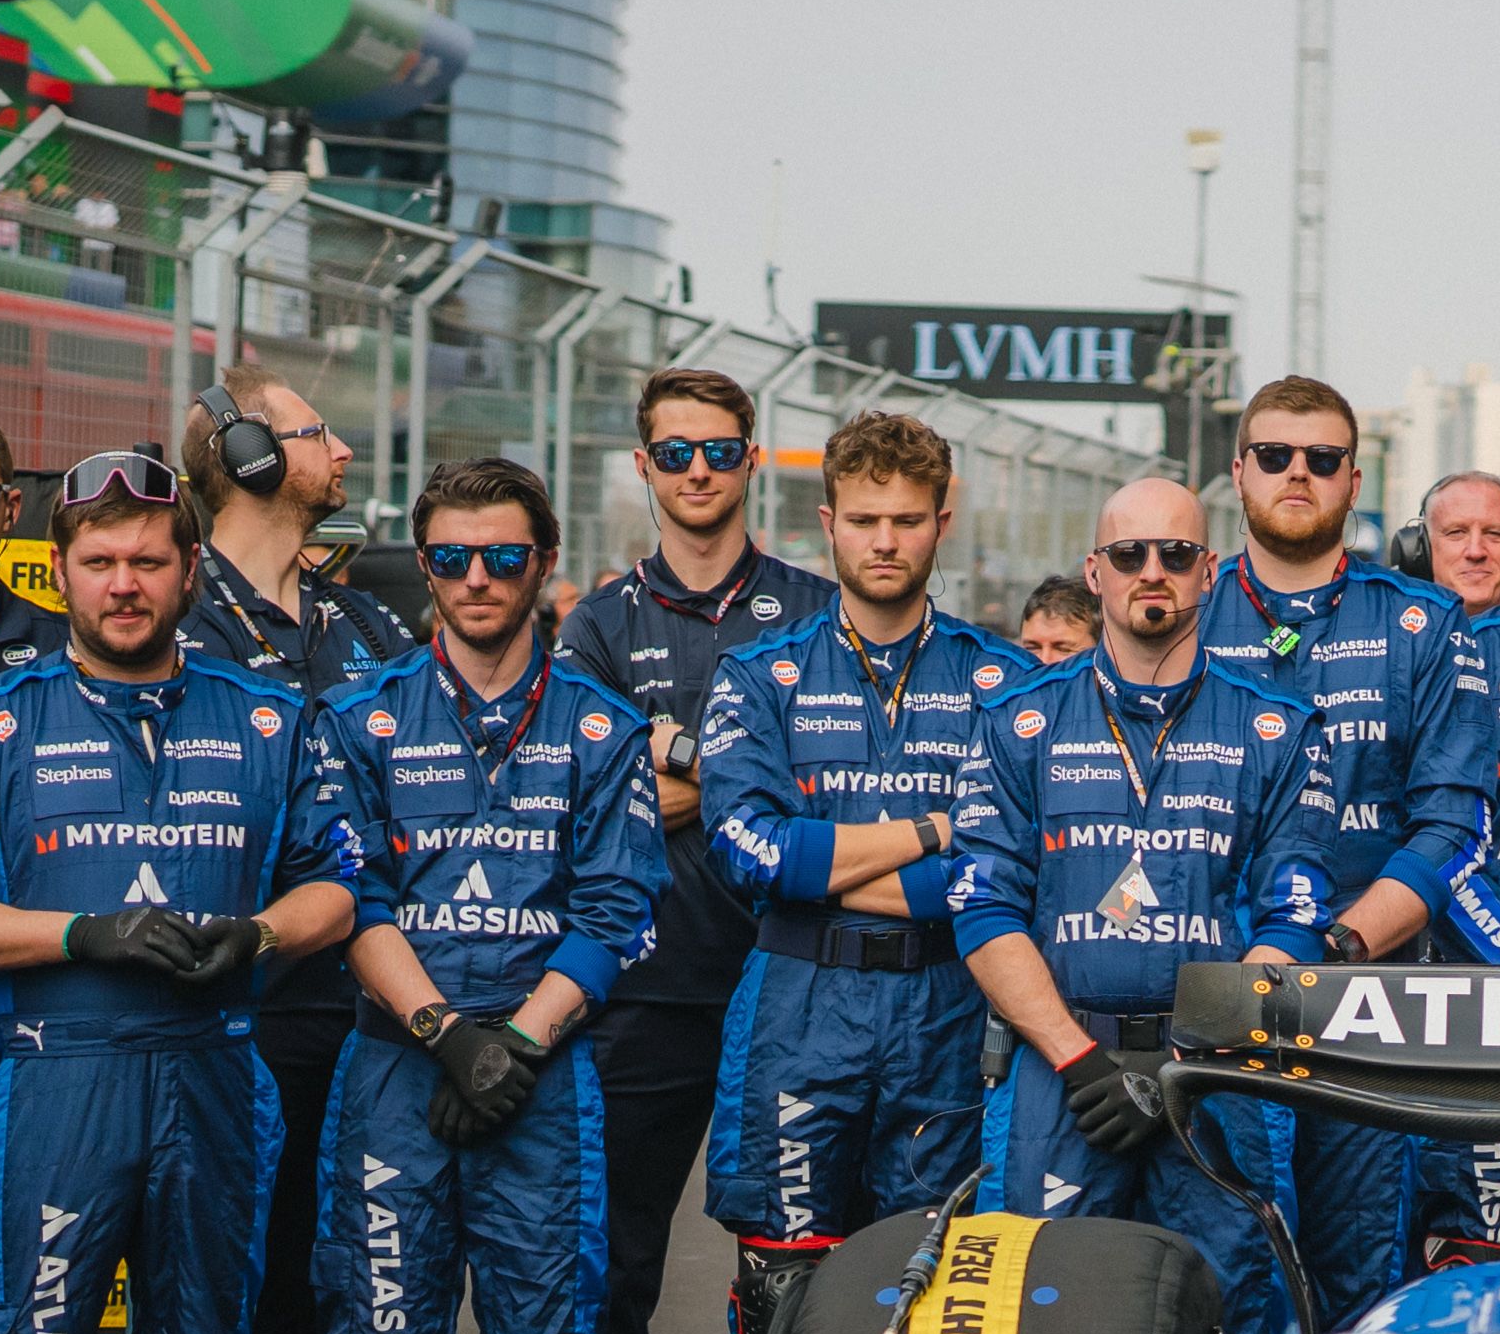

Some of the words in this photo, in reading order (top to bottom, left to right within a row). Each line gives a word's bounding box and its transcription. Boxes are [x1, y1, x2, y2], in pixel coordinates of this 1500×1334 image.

[913, 321, 1136, 385] LVMH
[797, 693, 863, 706] KOMATSU
[1314, 689, 1383, 707] DURACELL
[794, 716, 862, 733] Stephens
[35, 739, 109, 756] KOMATSU
[392, 743, 461, 758] KOMATSU
[36, 765, 112, 785] Stephens
[395, 767, 465, 786] Stephens
[823, 770, 954, 794] MYPROTEI
[1051, 765, 1122, 783] Stephens
[169, 791, 241, 806] DURACELL
[1163, 795, 1234, 814] DURACELL
[66, 824, 245, 848] MYPROTEIN
[1071, 825, 1232, 856] MYPROTEIN
[1055, 914, 1222, 946] ATLASSIAN
[948, 1233, 1004, 1288] REAR
